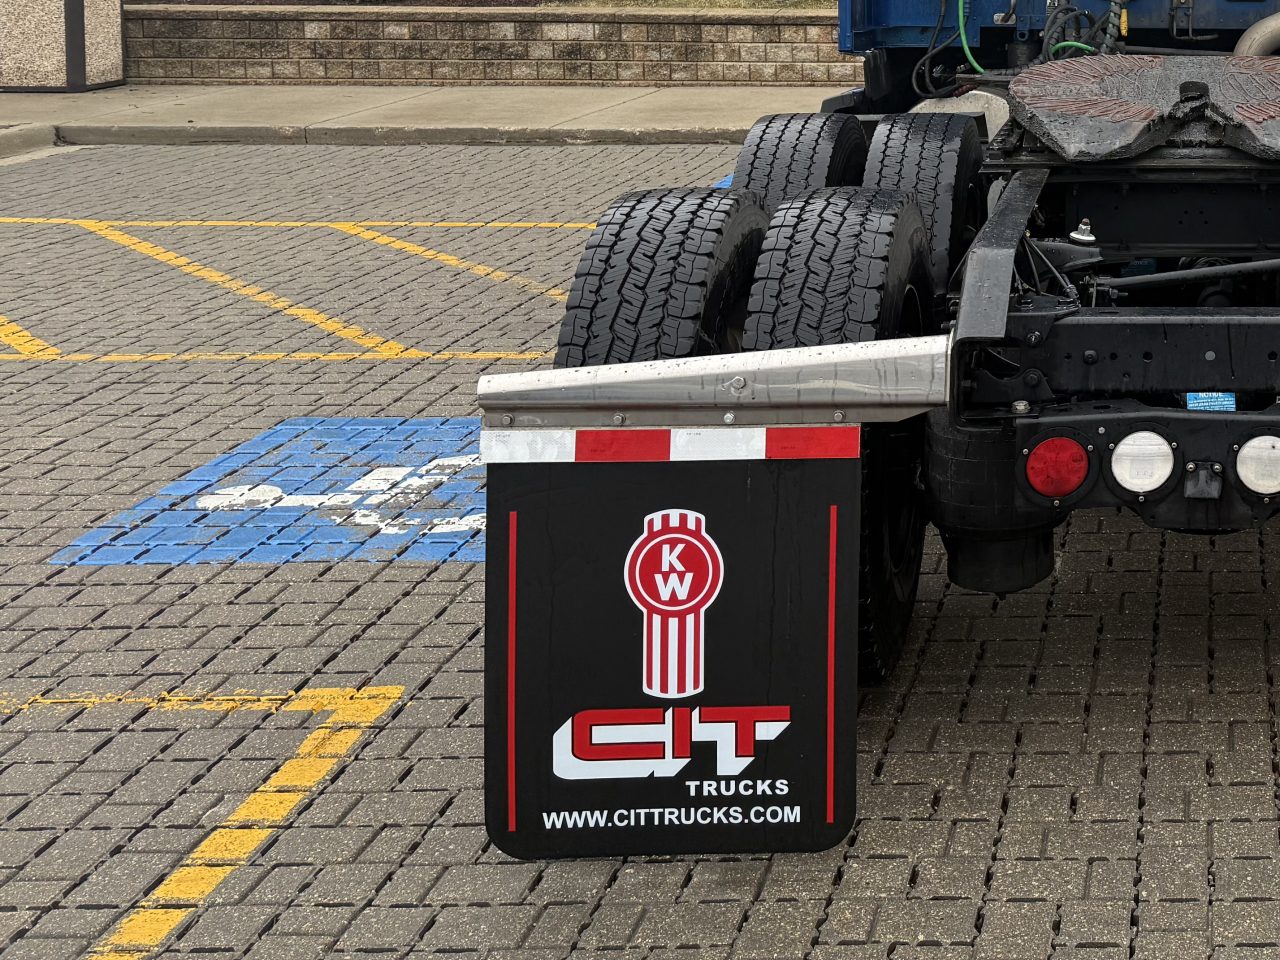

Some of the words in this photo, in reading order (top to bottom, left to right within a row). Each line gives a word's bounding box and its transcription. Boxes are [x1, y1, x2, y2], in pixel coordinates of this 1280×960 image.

[553, 705, 791, 780] CIT
[685, 779, 790, 797] TRUCKS
[542, 805, 801, 830] WWW.CITTRUCKS.COM
